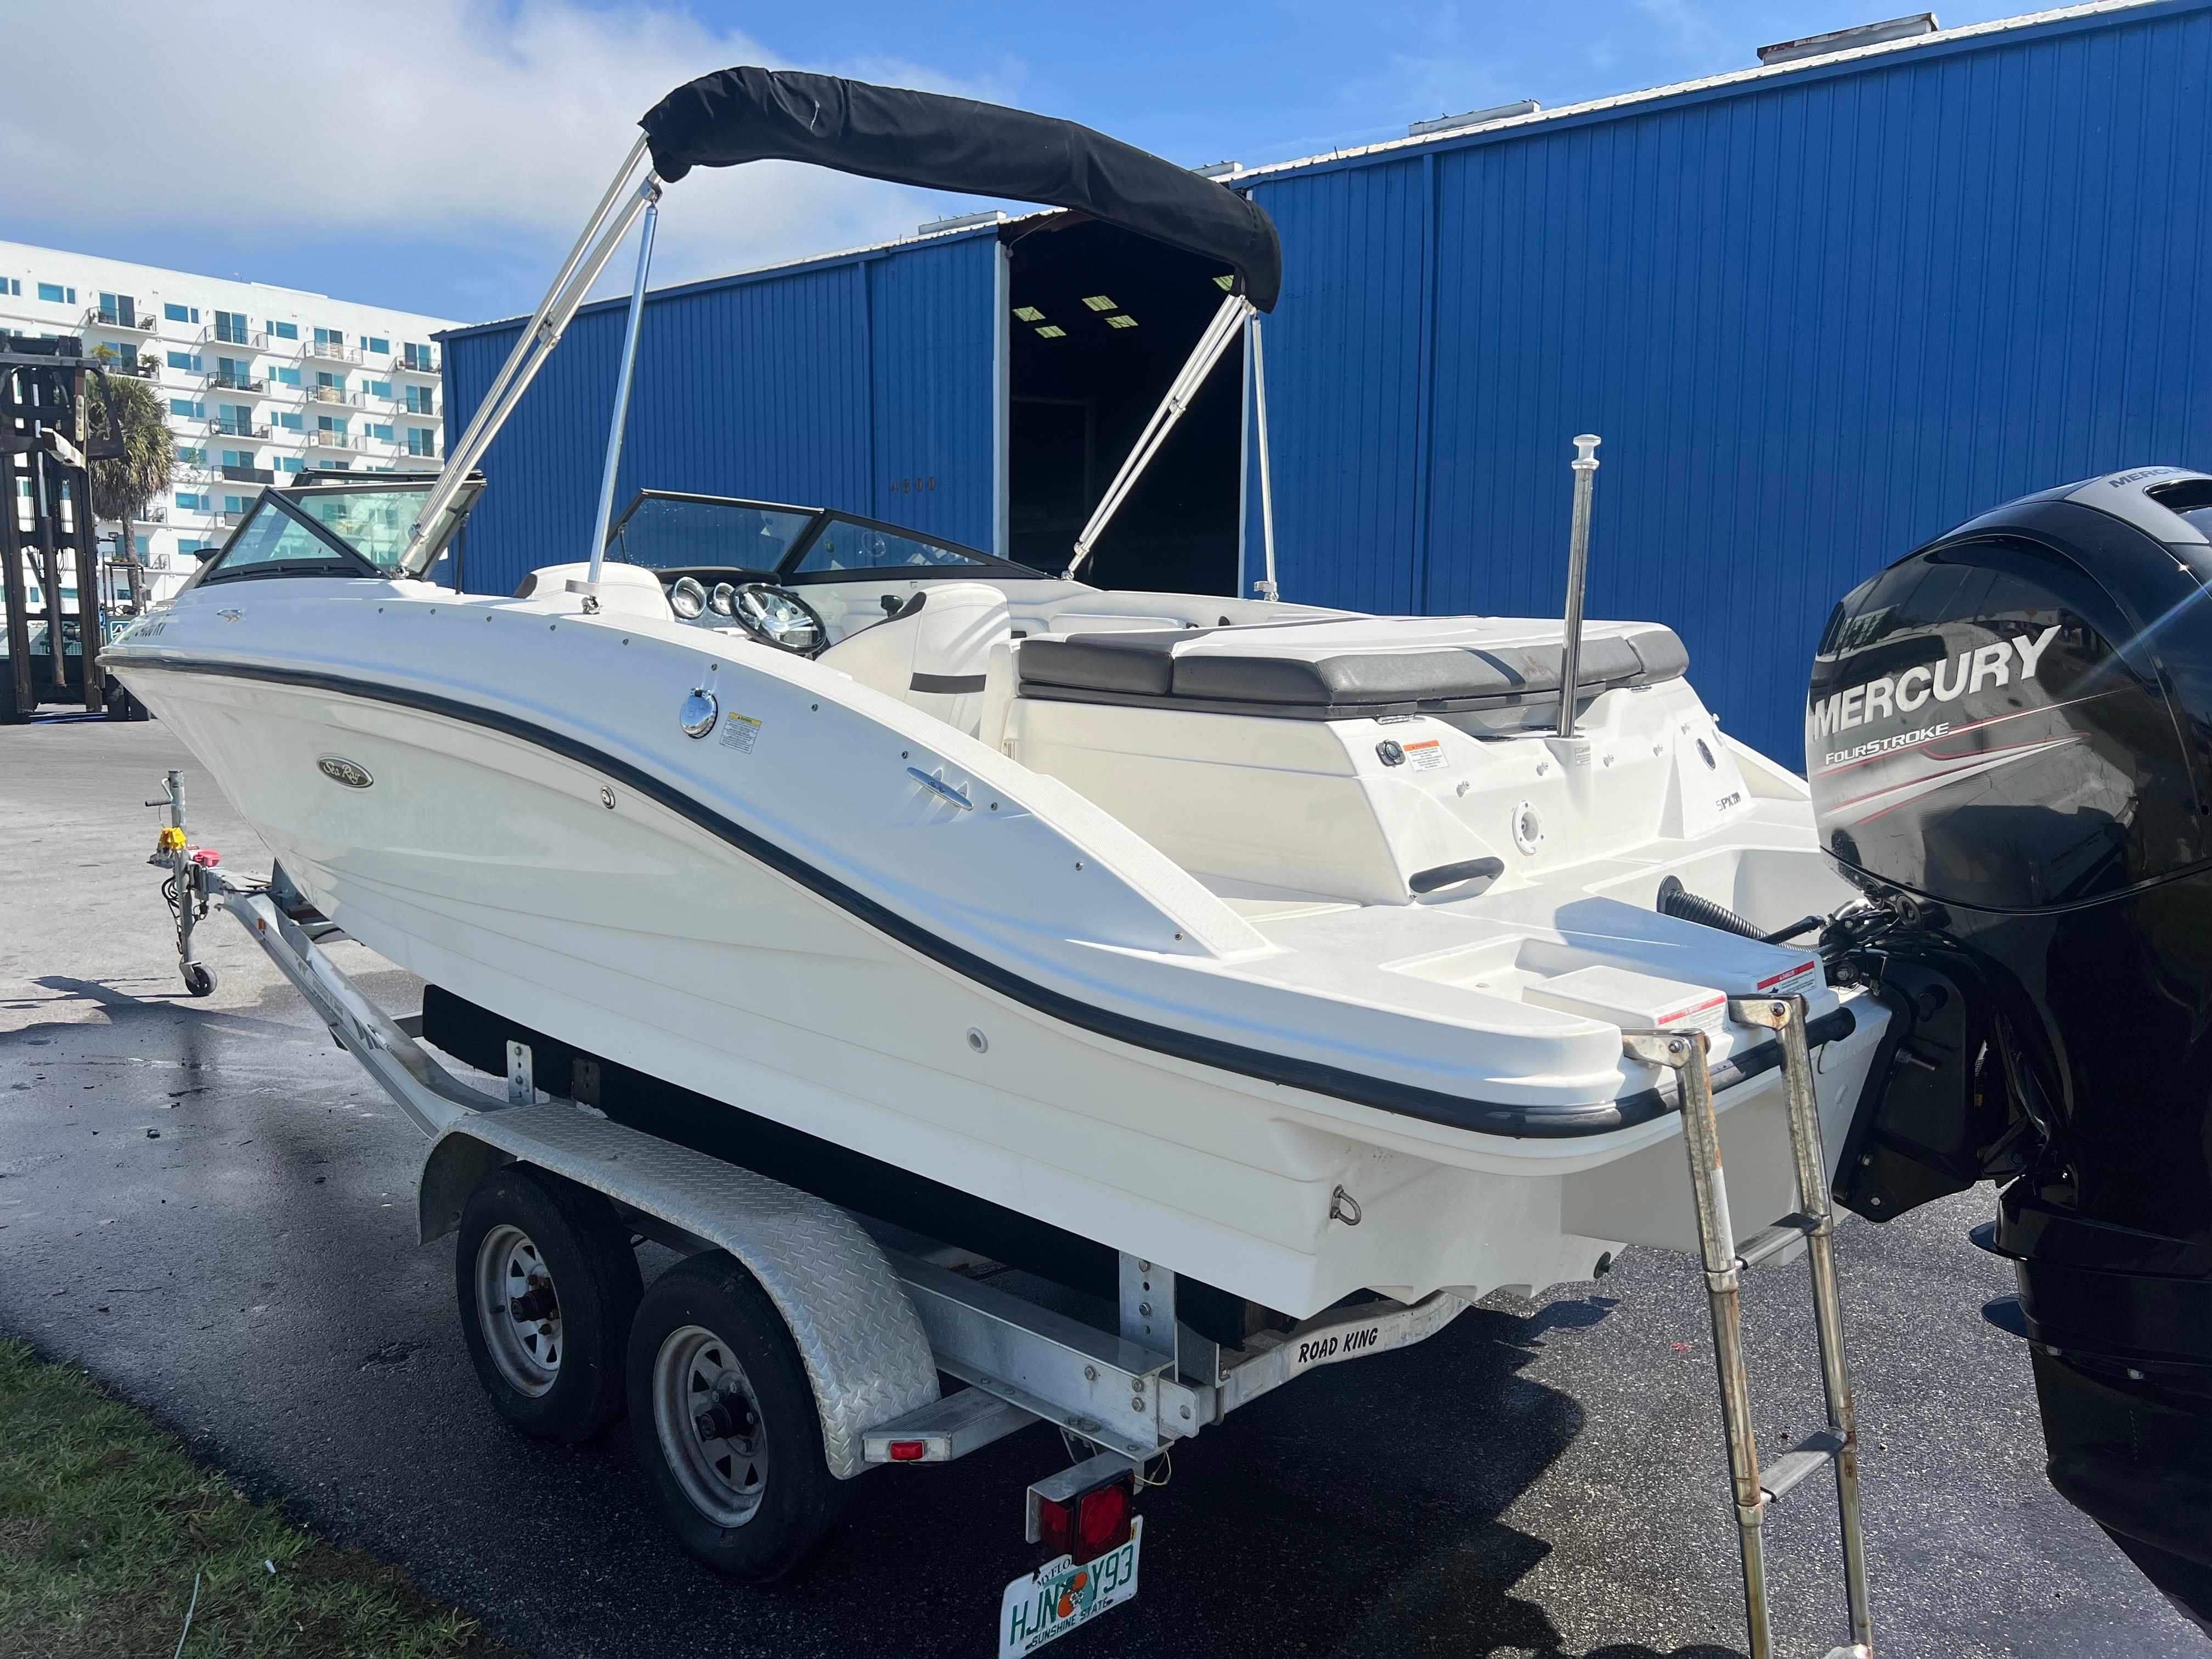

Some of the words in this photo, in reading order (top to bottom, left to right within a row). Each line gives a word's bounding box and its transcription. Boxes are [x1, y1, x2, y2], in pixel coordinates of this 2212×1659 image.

[1813, 625, 2061, 742] MERCURY
[323, 761, 341, 776] Sea
[342, 764, 360, 785] Ray
[1298, 1336, 1338, 1363] ROAD
[1342, 1327, 1379, 1352] KING
[1031, 1615, 1076, 1647] SUNSHINE
[1080, 1597, 1108, 1621] STATE
